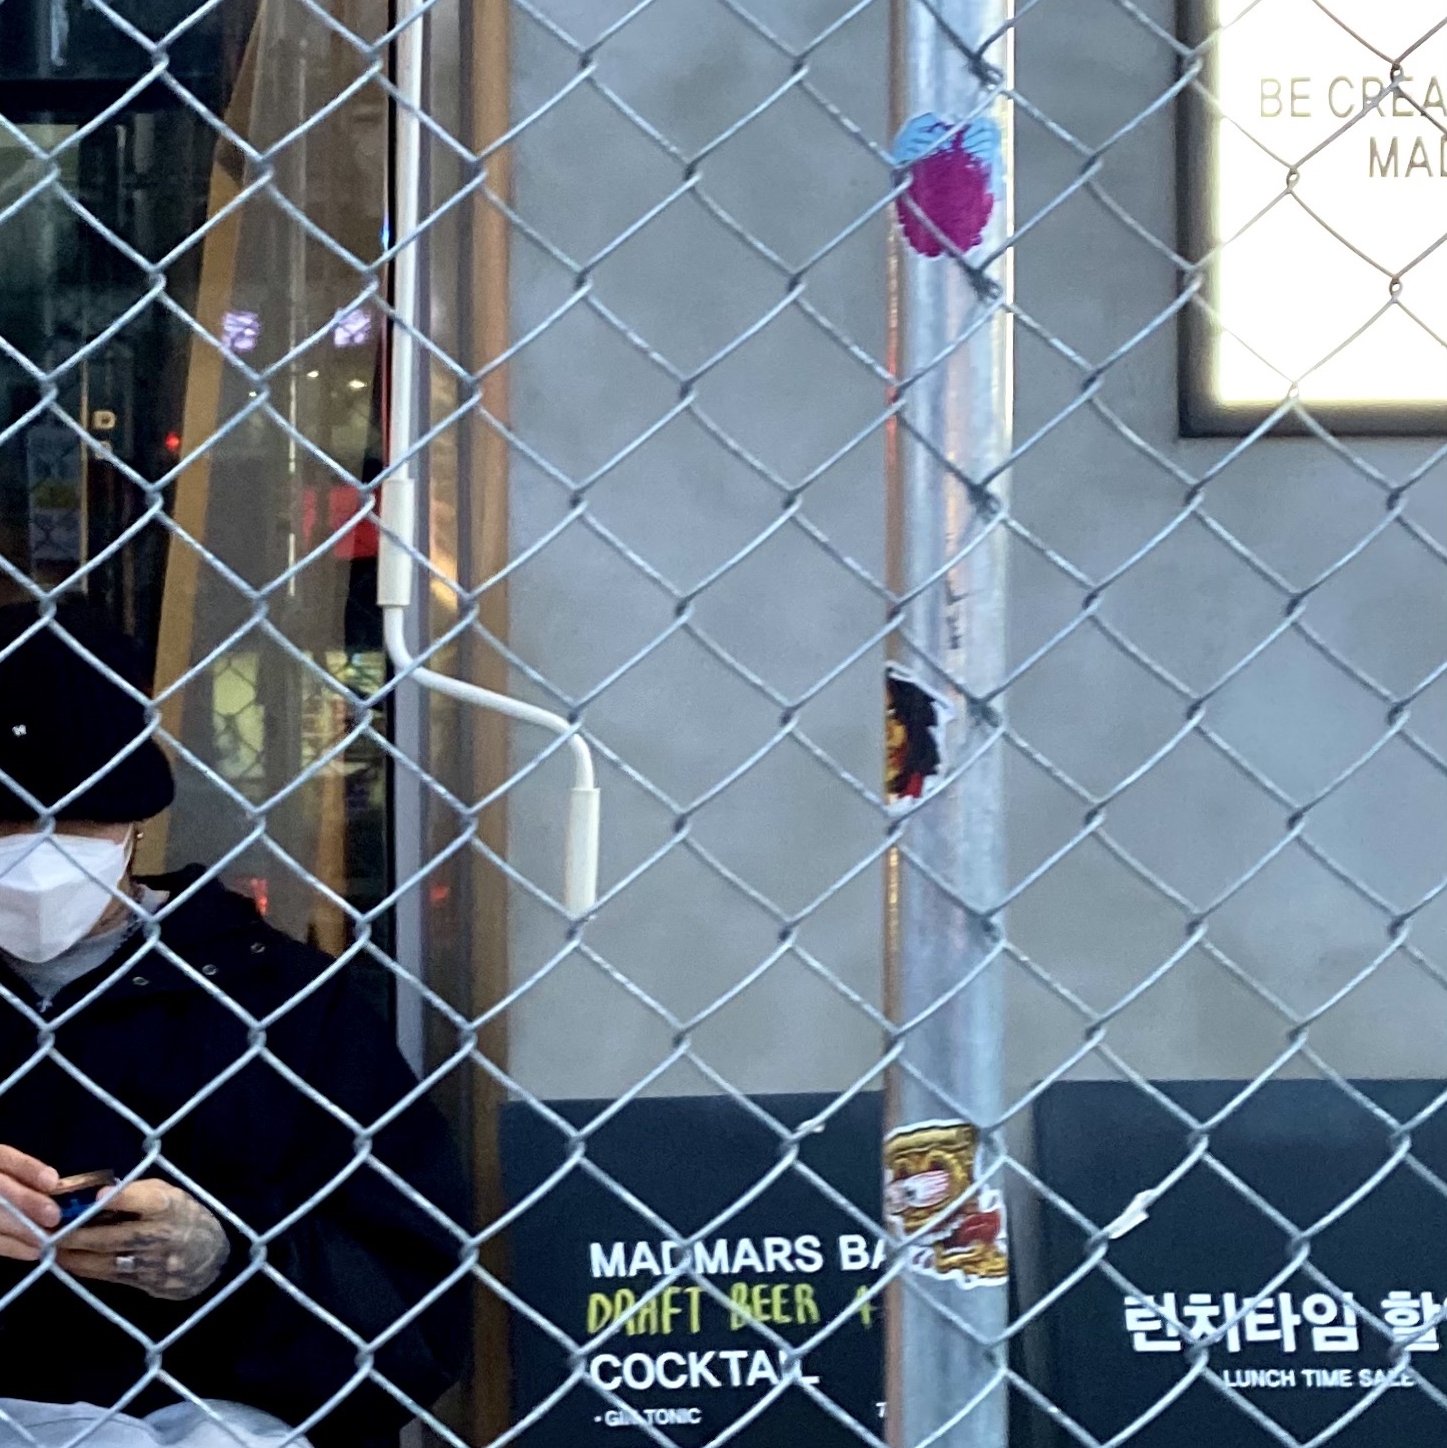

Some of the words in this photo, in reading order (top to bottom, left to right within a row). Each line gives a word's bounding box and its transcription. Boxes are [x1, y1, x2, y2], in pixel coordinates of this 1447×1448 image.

[1260, 77, 1311, 117] BE
[695, 1235, 823, 1274] MARS
[587, 1287, 703, 1336] DRAFT
[729, 1282, 821, 1330] BEER
[1124, 1292, 1359, 1352] 런치타임
[1381, 1291, 1447, 1351] 할
[1223, 1369, 1295, 1388] LUNCH
[1301, 1369, 1352, 1387] TIME
